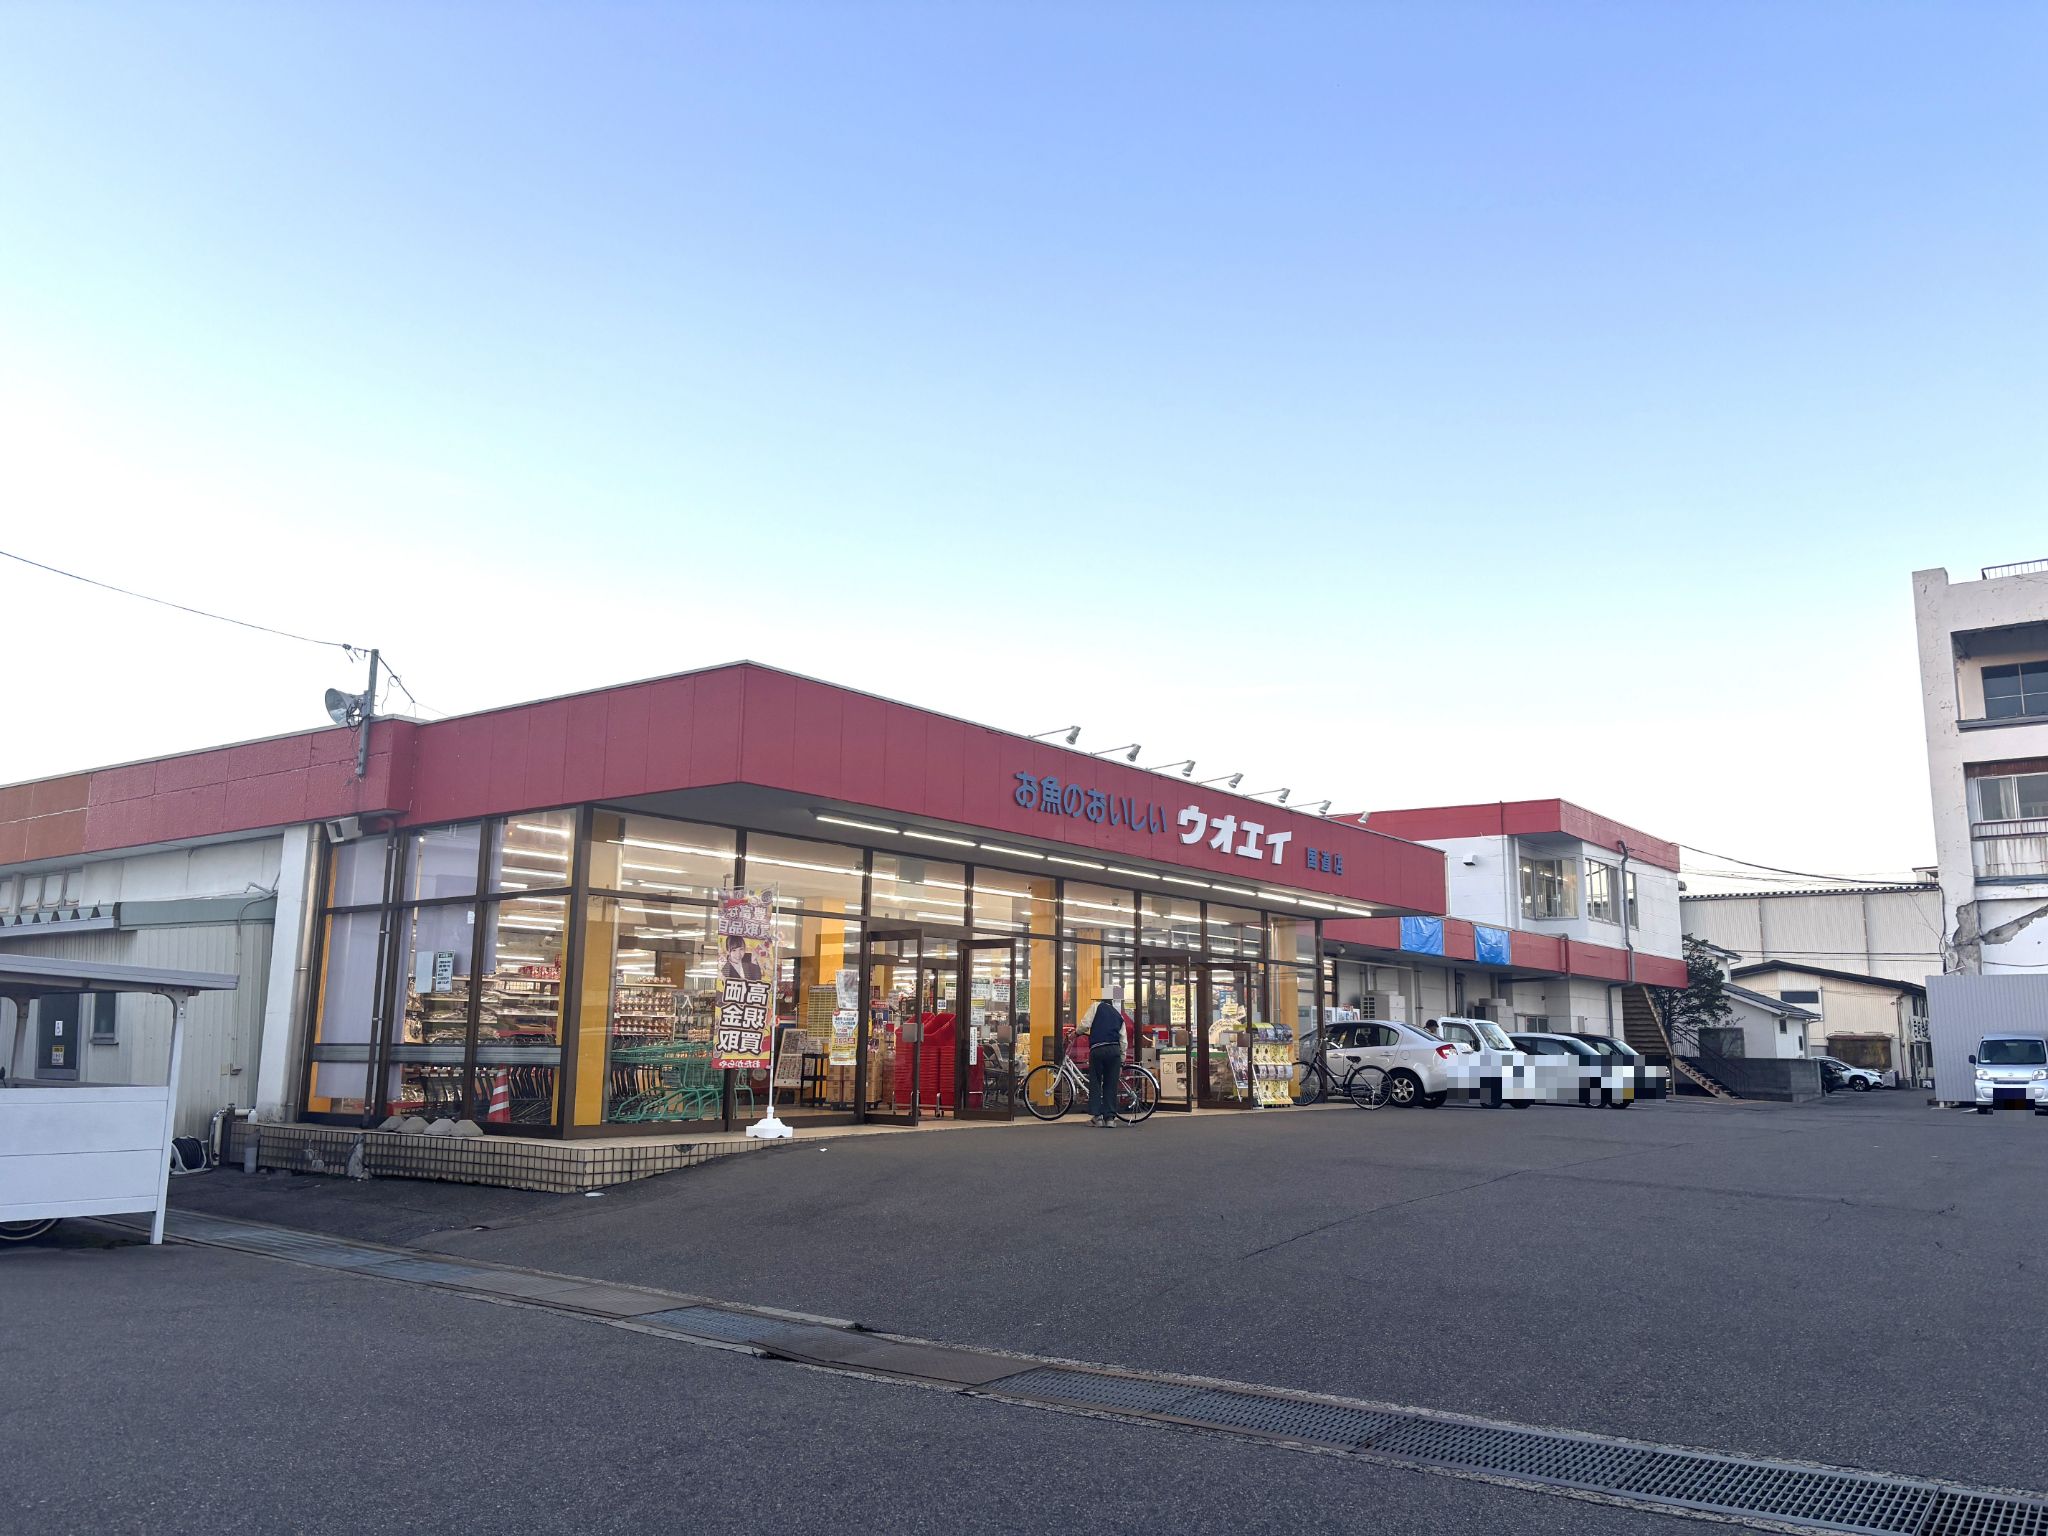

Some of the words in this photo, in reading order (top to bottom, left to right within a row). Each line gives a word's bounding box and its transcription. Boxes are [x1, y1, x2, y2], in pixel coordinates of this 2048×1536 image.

[1015, 771, 1168, 833] お魚のおいしい
[1177, 805, 1292, 865] ウオエイ
